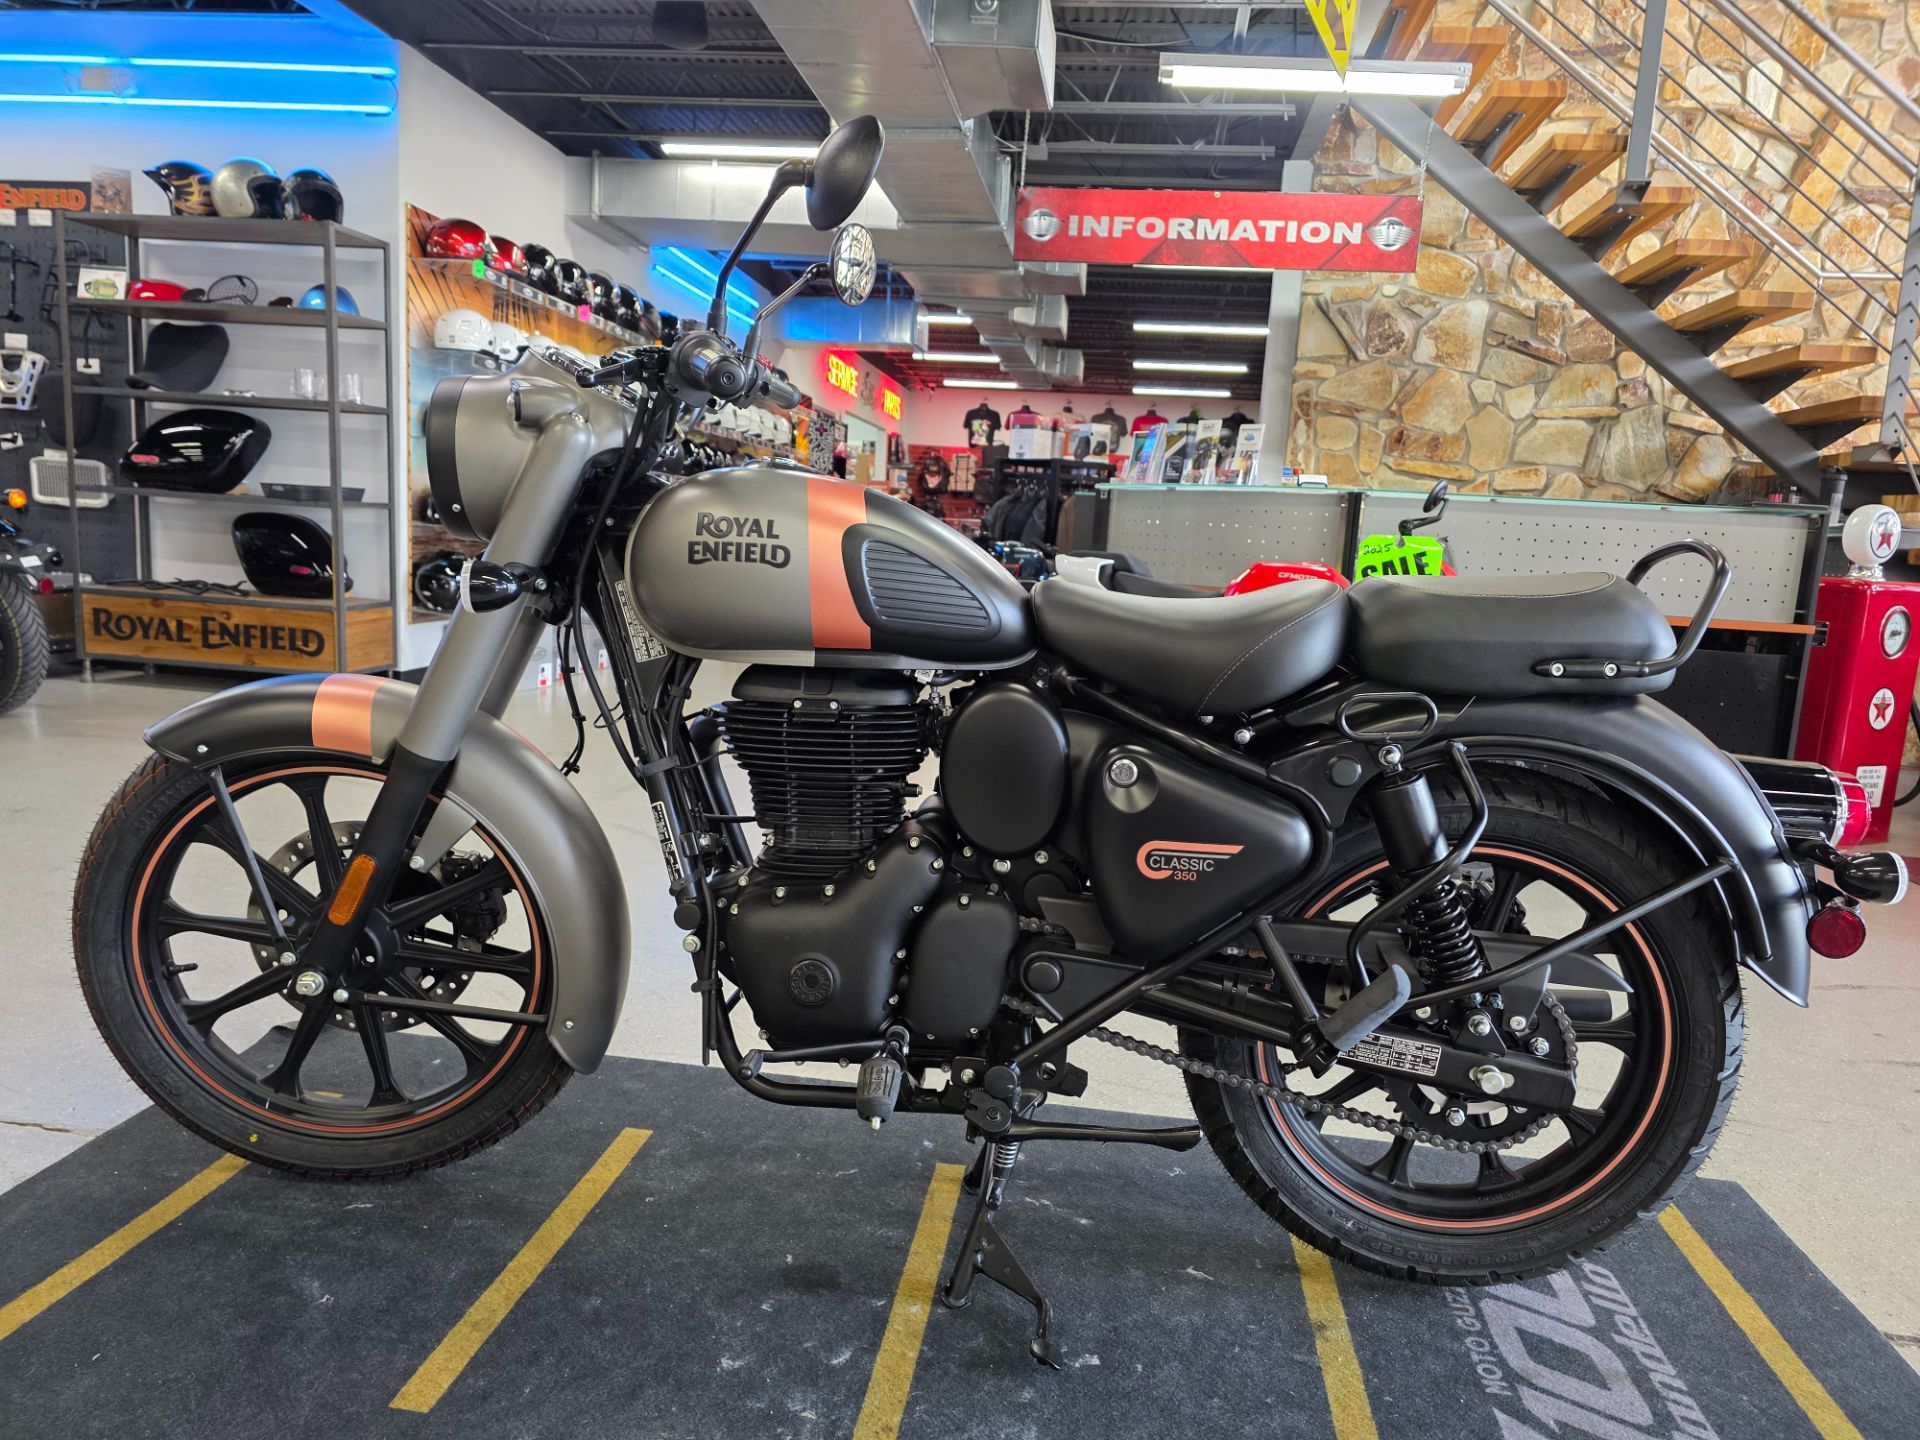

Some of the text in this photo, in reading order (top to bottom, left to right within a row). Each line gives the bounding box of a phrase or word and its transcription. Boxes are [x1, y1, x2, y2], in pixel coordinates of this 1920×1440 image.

[1068, 214, 1362, 244] INFORMATION
[828, 354, 858, 398] SERVICE
[695, 511, 780, 539] ROYAL
[688, 540, 791, 569] ENFIELD
[1361, 551, 1433, 578] SALE
[92, 607, 325, 658] ROYAL ENFIELD
[1149, 854, 1214, 872] CLASSIC
[1173, 871, 1197, 881] 350
[1581, 1262, 1720, 1440] andello
[1465, 1336, 1512, 1396] MOTO
